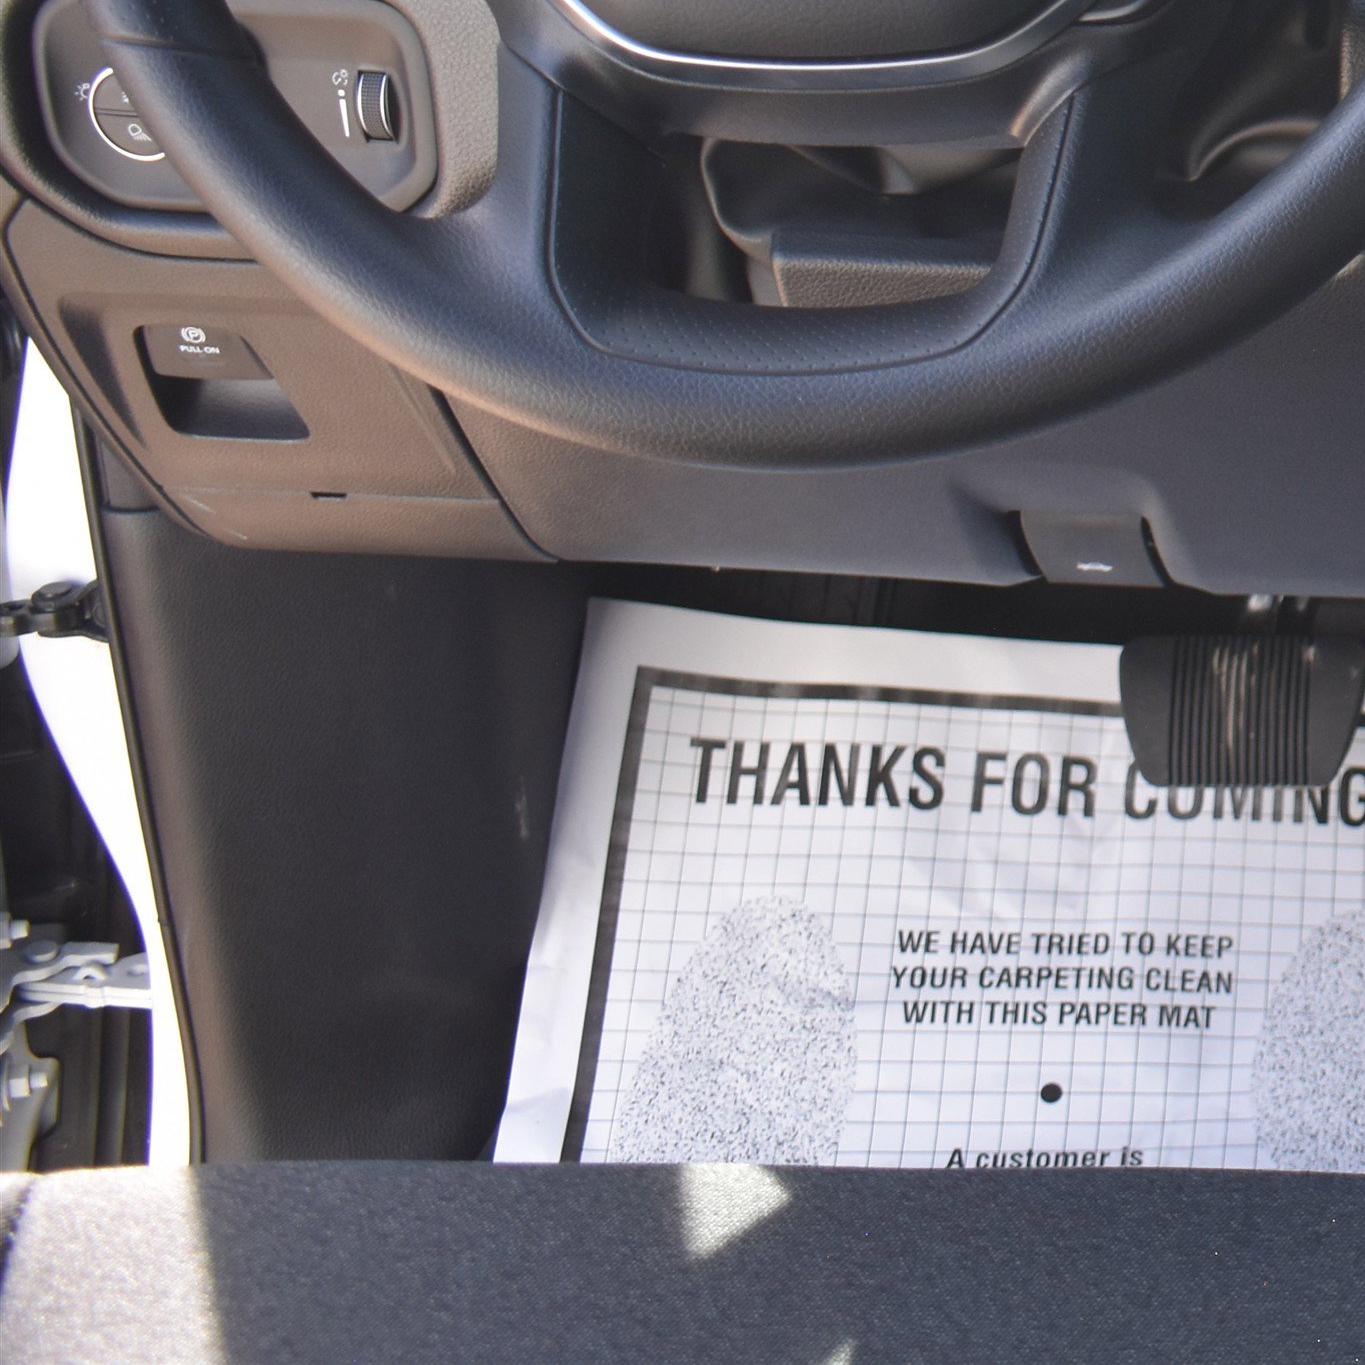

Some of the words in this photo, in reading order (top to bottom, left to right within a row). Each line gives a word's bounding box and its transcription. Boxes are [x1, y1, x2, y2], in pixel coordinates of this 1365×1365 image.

[180, 345, 203, 353] PULL
[690, 737, 946, 811] THANKS
[970, 750, 1098, 817] FOR
[898, 929, 941, 955] WE
[951, 931, 1022, 956] HAVE
[1031, 931, 1110, 957] TRIED
[1121, 931, 1155, 957] TO
[1165, 933, 1234, 960] KEEP
[891, 965, 968, 989] YOUR
[978, 965, 1136, 991] CARPETING
[1145, 967, 1234, 995] CLEAN
[902, 1000, 974, 1025] WITH
[984, 1001, 1048, 1026] THIS
[1058, 1001, 1148, 1027] PAPER
[1157, 1004, 1217, 1030] MAT
[946, 1147, 965, 1168] A
[976, 1146, 1111, 1168] customer
[1120, 1145, 1144, 1167] is
